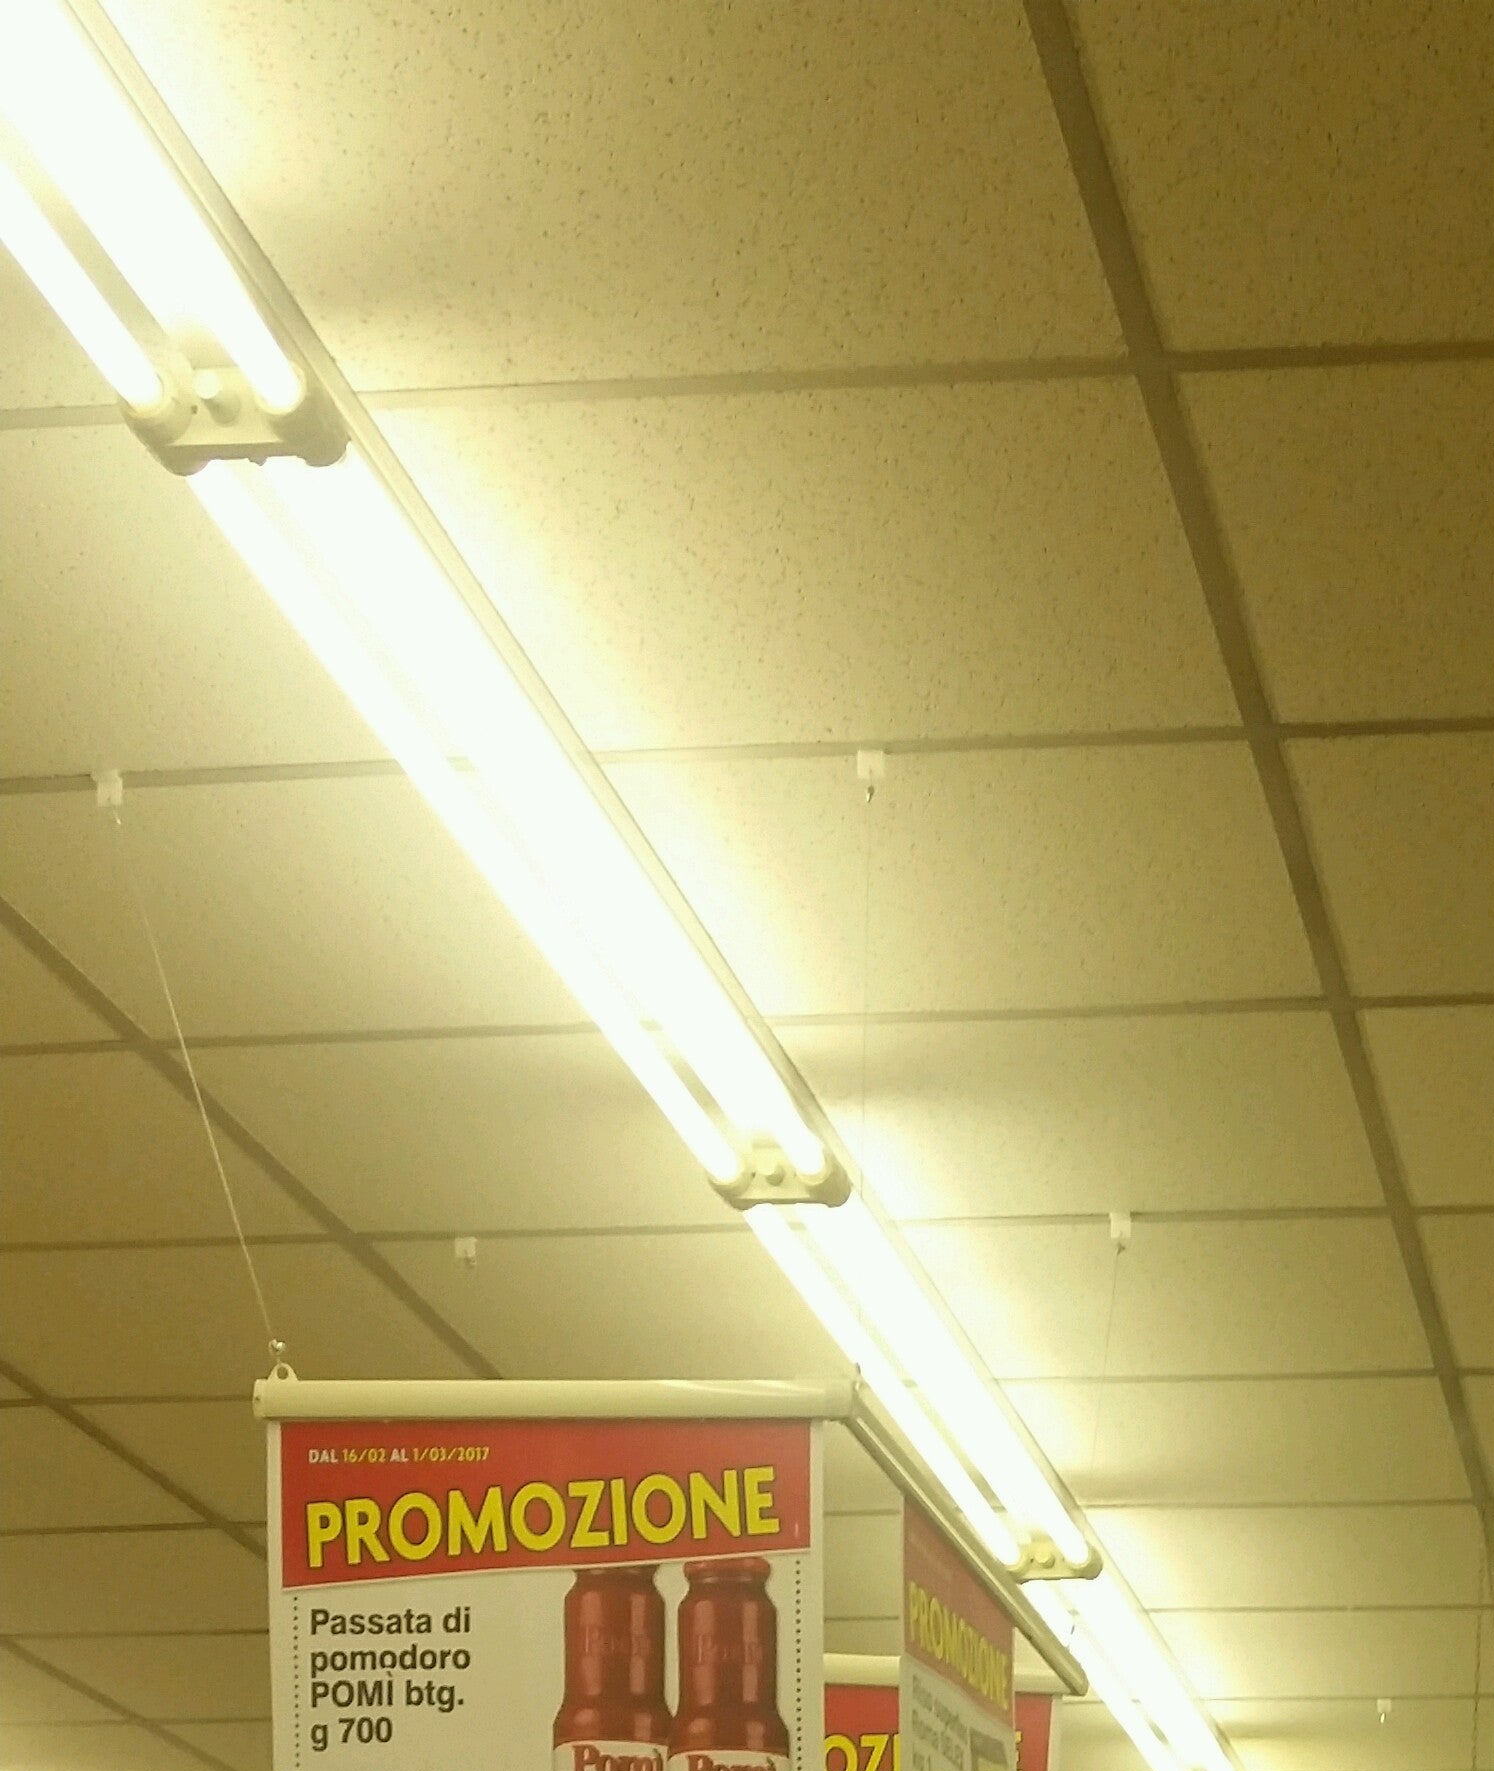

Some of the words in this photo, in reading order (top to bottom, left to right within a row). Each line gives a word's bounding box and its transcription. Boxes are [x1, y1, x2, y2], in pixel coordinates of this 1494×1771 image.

[307, 1449, 338, 1464] DAL
[342, 1448, 386, 1463] 16/02
[390, 1448, 409, 1463] AL
[412, 1446, 490, 1463] 1/03/2017
[306, 1466, 781, 1568] PROMOZIONE
[310, 1608, 432, 1635] Passata
[442, 1606, 471, 1634] di
[310, 1643, 471, 1679] pomodoro
[310, 1670, 393, 1708] POMÌ
[405, 1679, 464, 1713] btg.
[310, 1723, 329, 1751] g
[338, 1716, 393, 1744] 700
